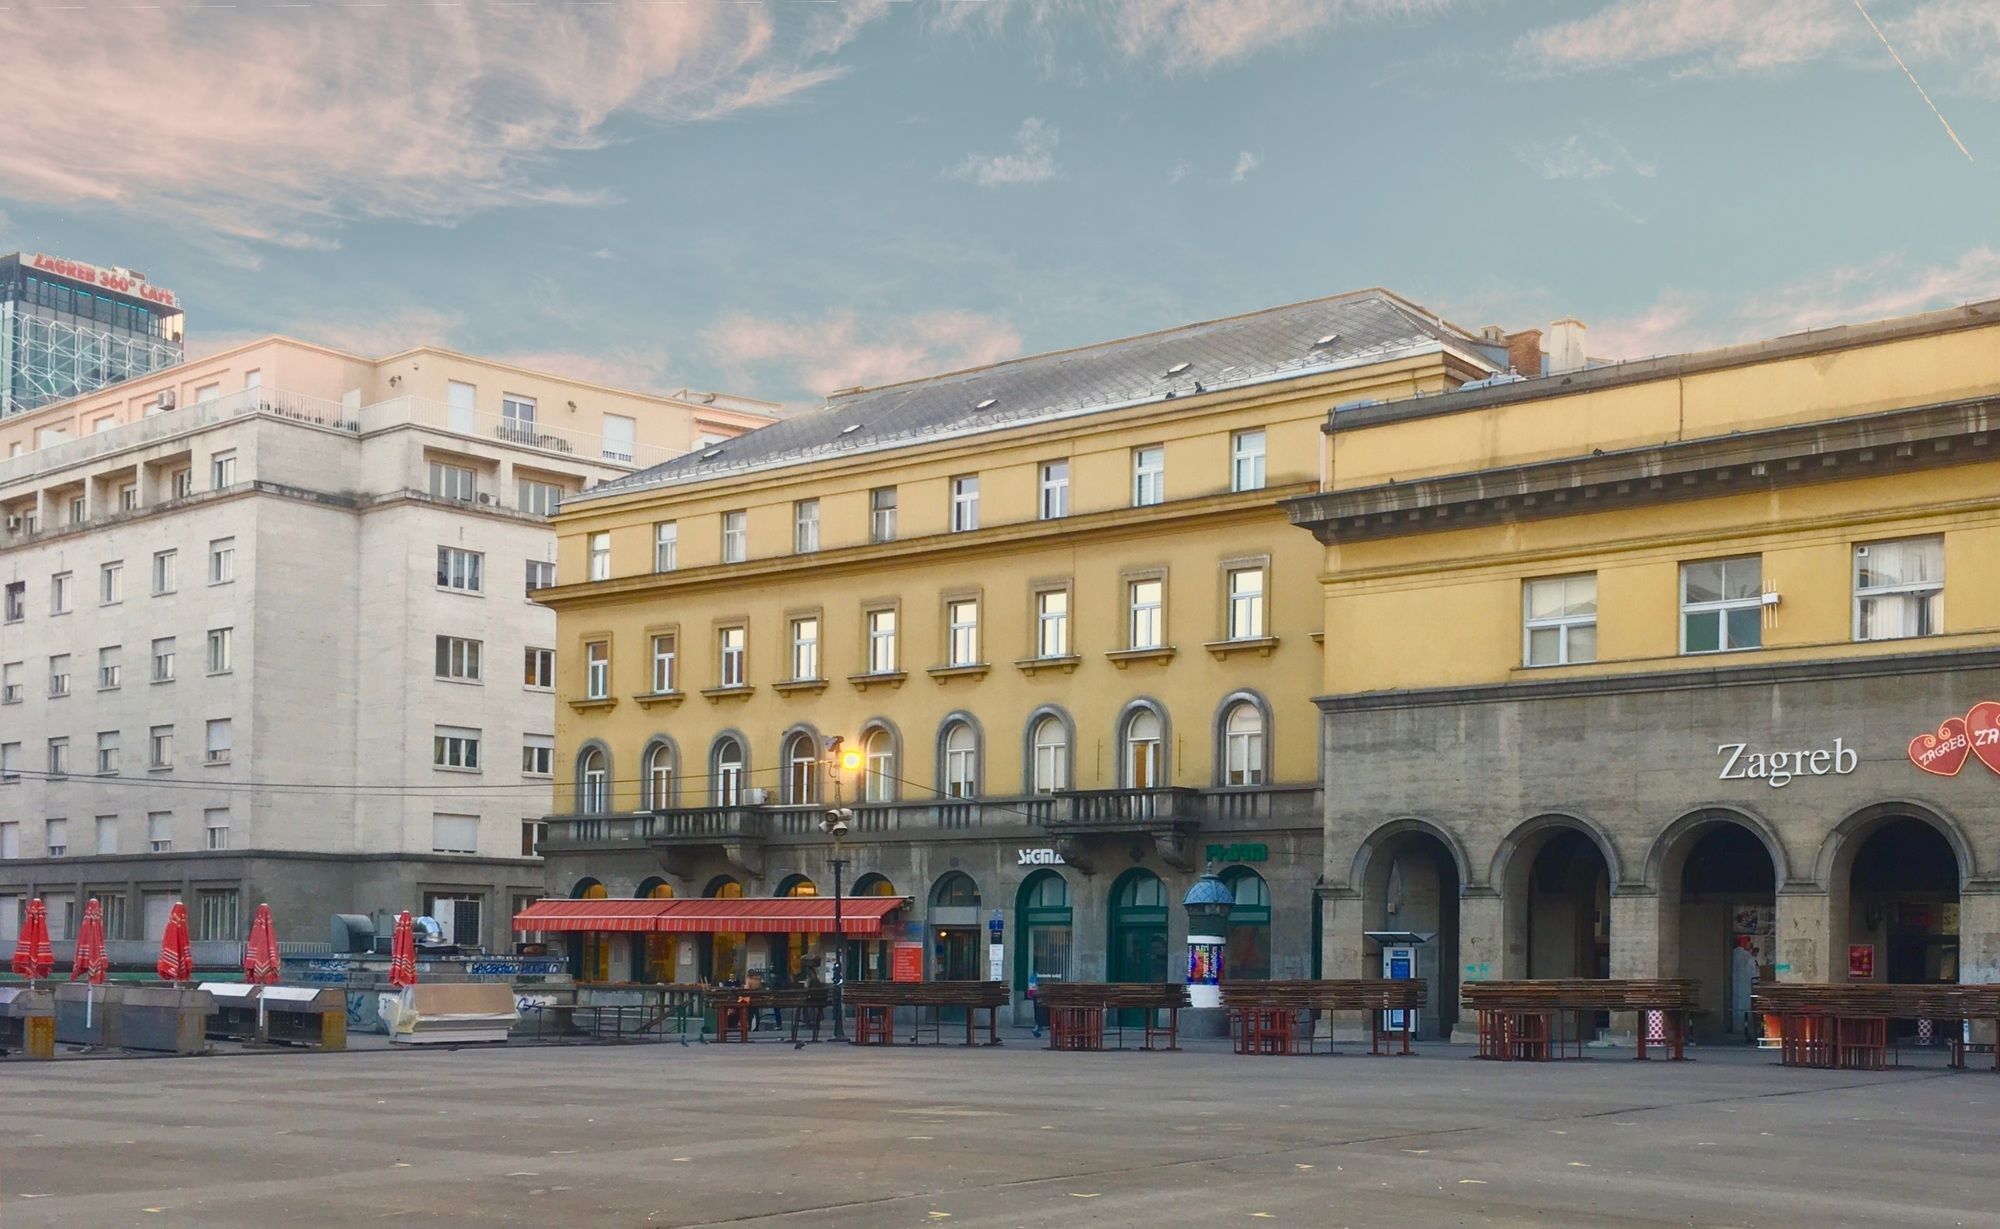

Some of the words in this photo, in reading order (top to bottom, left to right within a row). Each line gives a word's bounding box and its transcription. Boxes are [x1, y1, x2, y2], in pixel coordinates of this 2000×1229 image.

[34, 253, 96, 283] ZAGREB
[1718, 738, 1858, 787] Zagreb
[1919, 735, 1967, 766] ZAGREB
